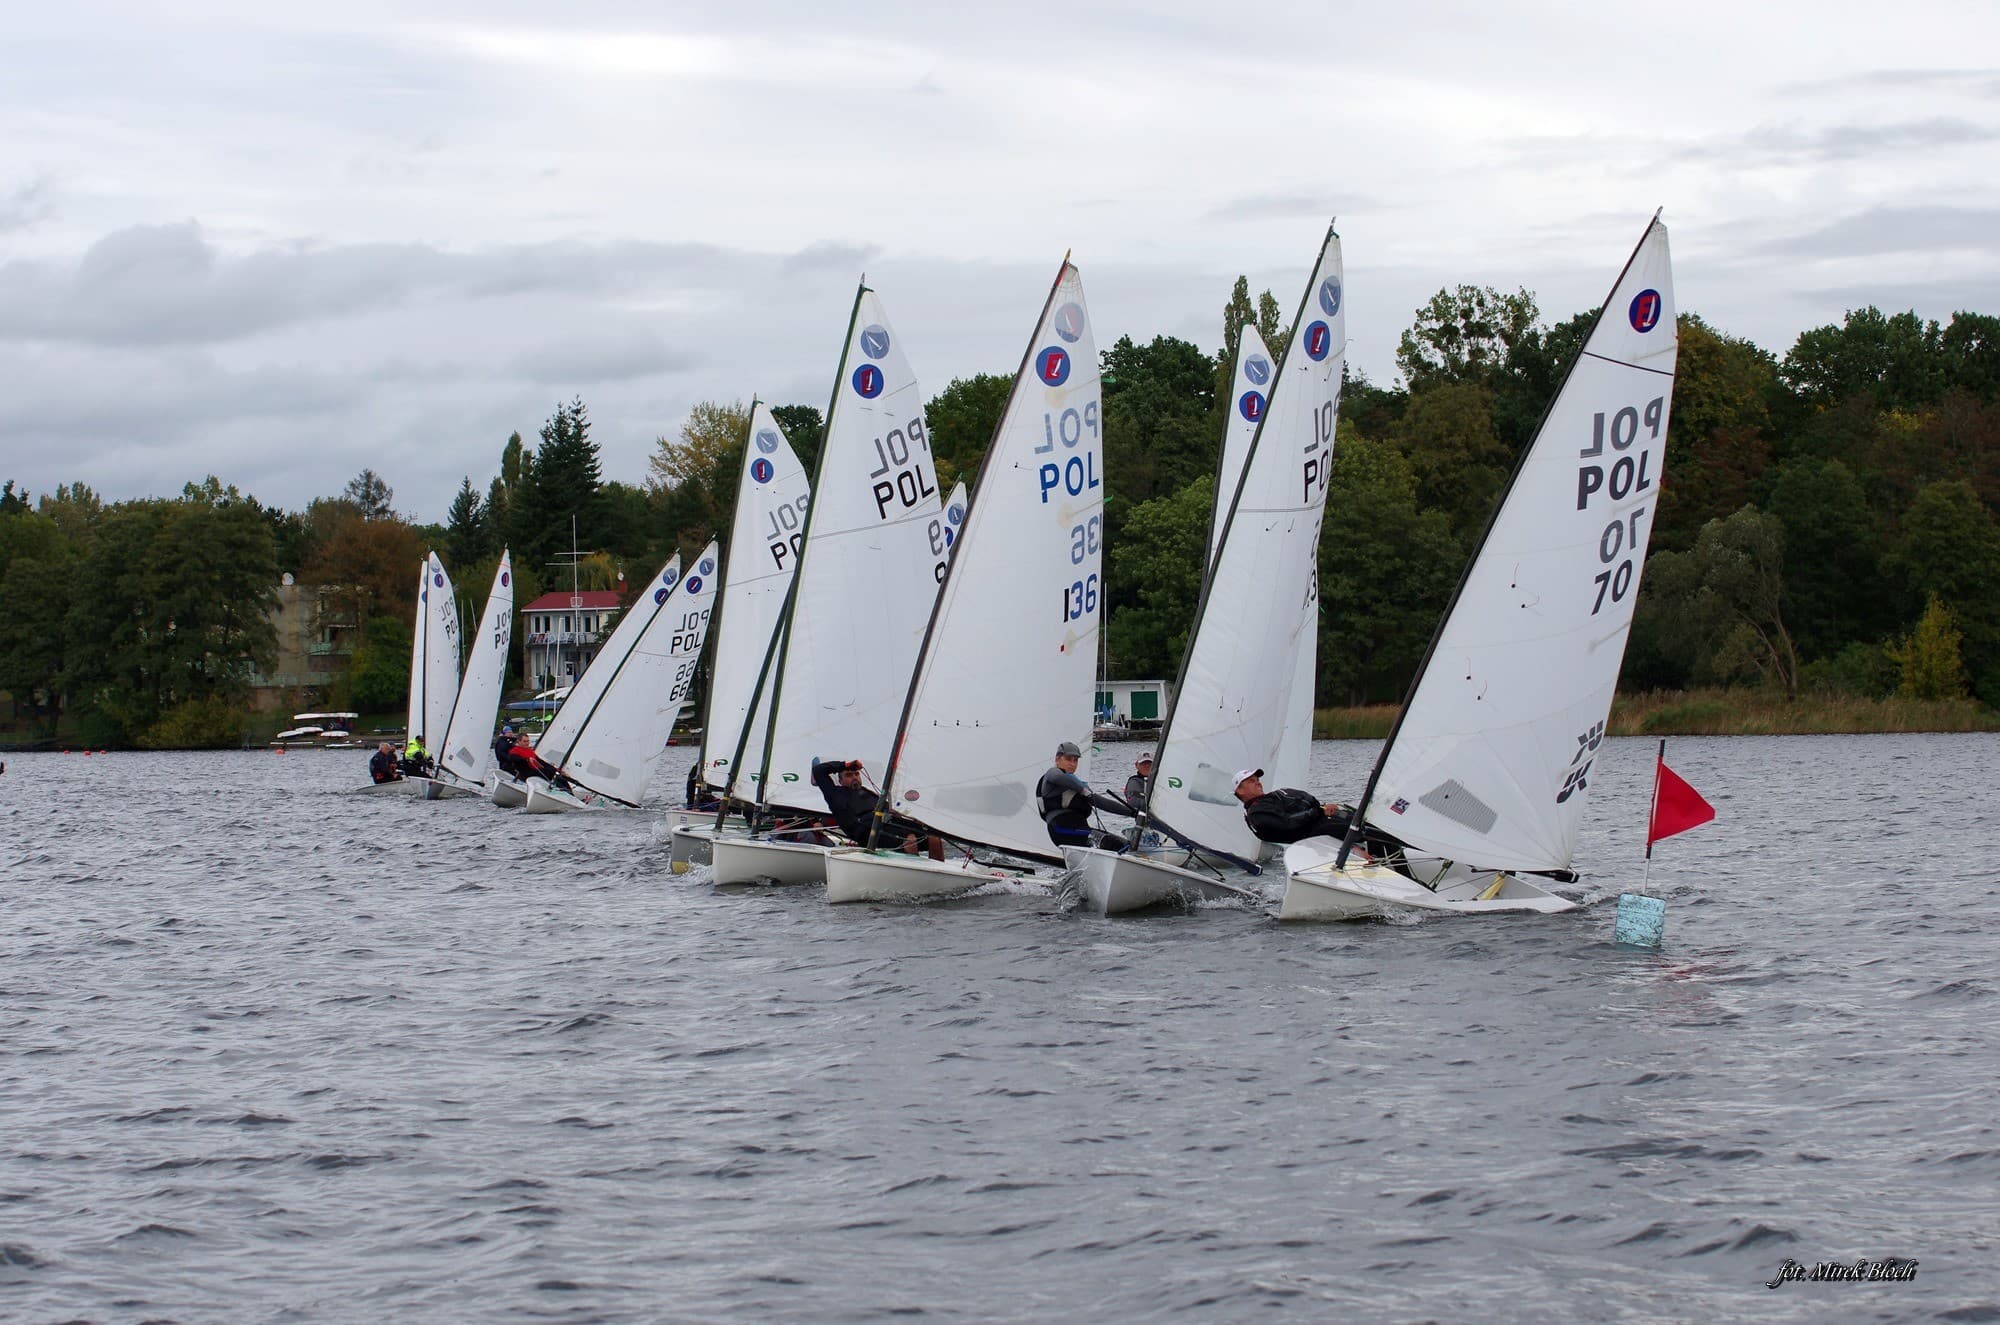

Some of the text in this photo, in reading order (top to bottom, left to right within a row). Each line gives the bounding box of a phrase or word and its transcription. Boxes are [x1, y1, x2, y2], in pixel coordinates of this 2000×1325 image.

[873, 465, 935, 520] POL
[1040, 452, 1099, 503] POL
[1577, 450, 1650, 510] POL
[1064, 573, 1097, 623] 136
[1591, 560, 1632, 616] 70
[671, 632, 701, 655] POL
[669, 680, 689, 701] 66
